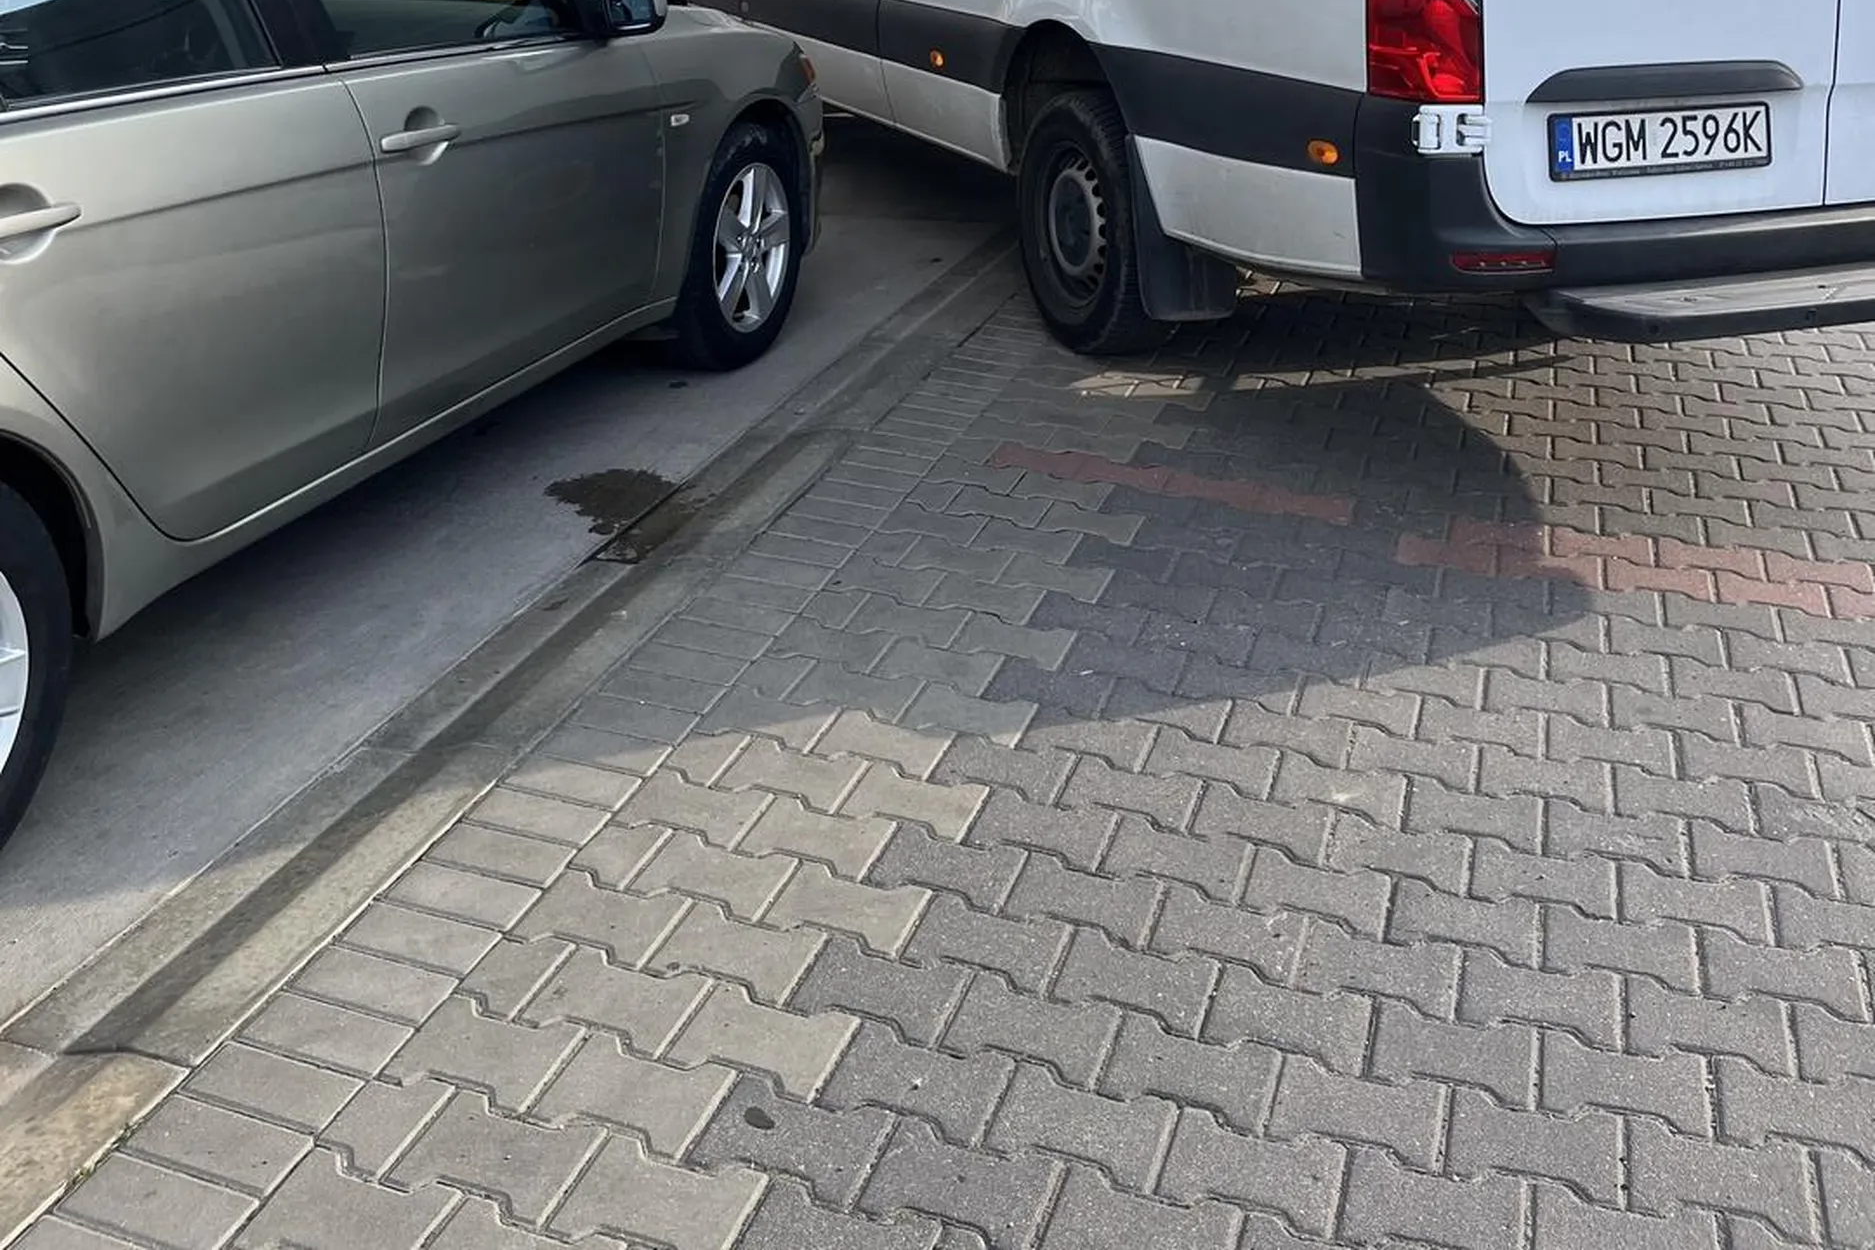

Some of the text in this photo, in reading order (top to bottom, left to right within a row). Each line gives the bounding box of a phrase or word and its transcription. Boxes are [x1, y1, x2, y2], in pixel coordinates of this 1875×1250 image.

[1577, 110, 1764, 165] WGM 2596K
[1557, 151, 1572, 163] PL
